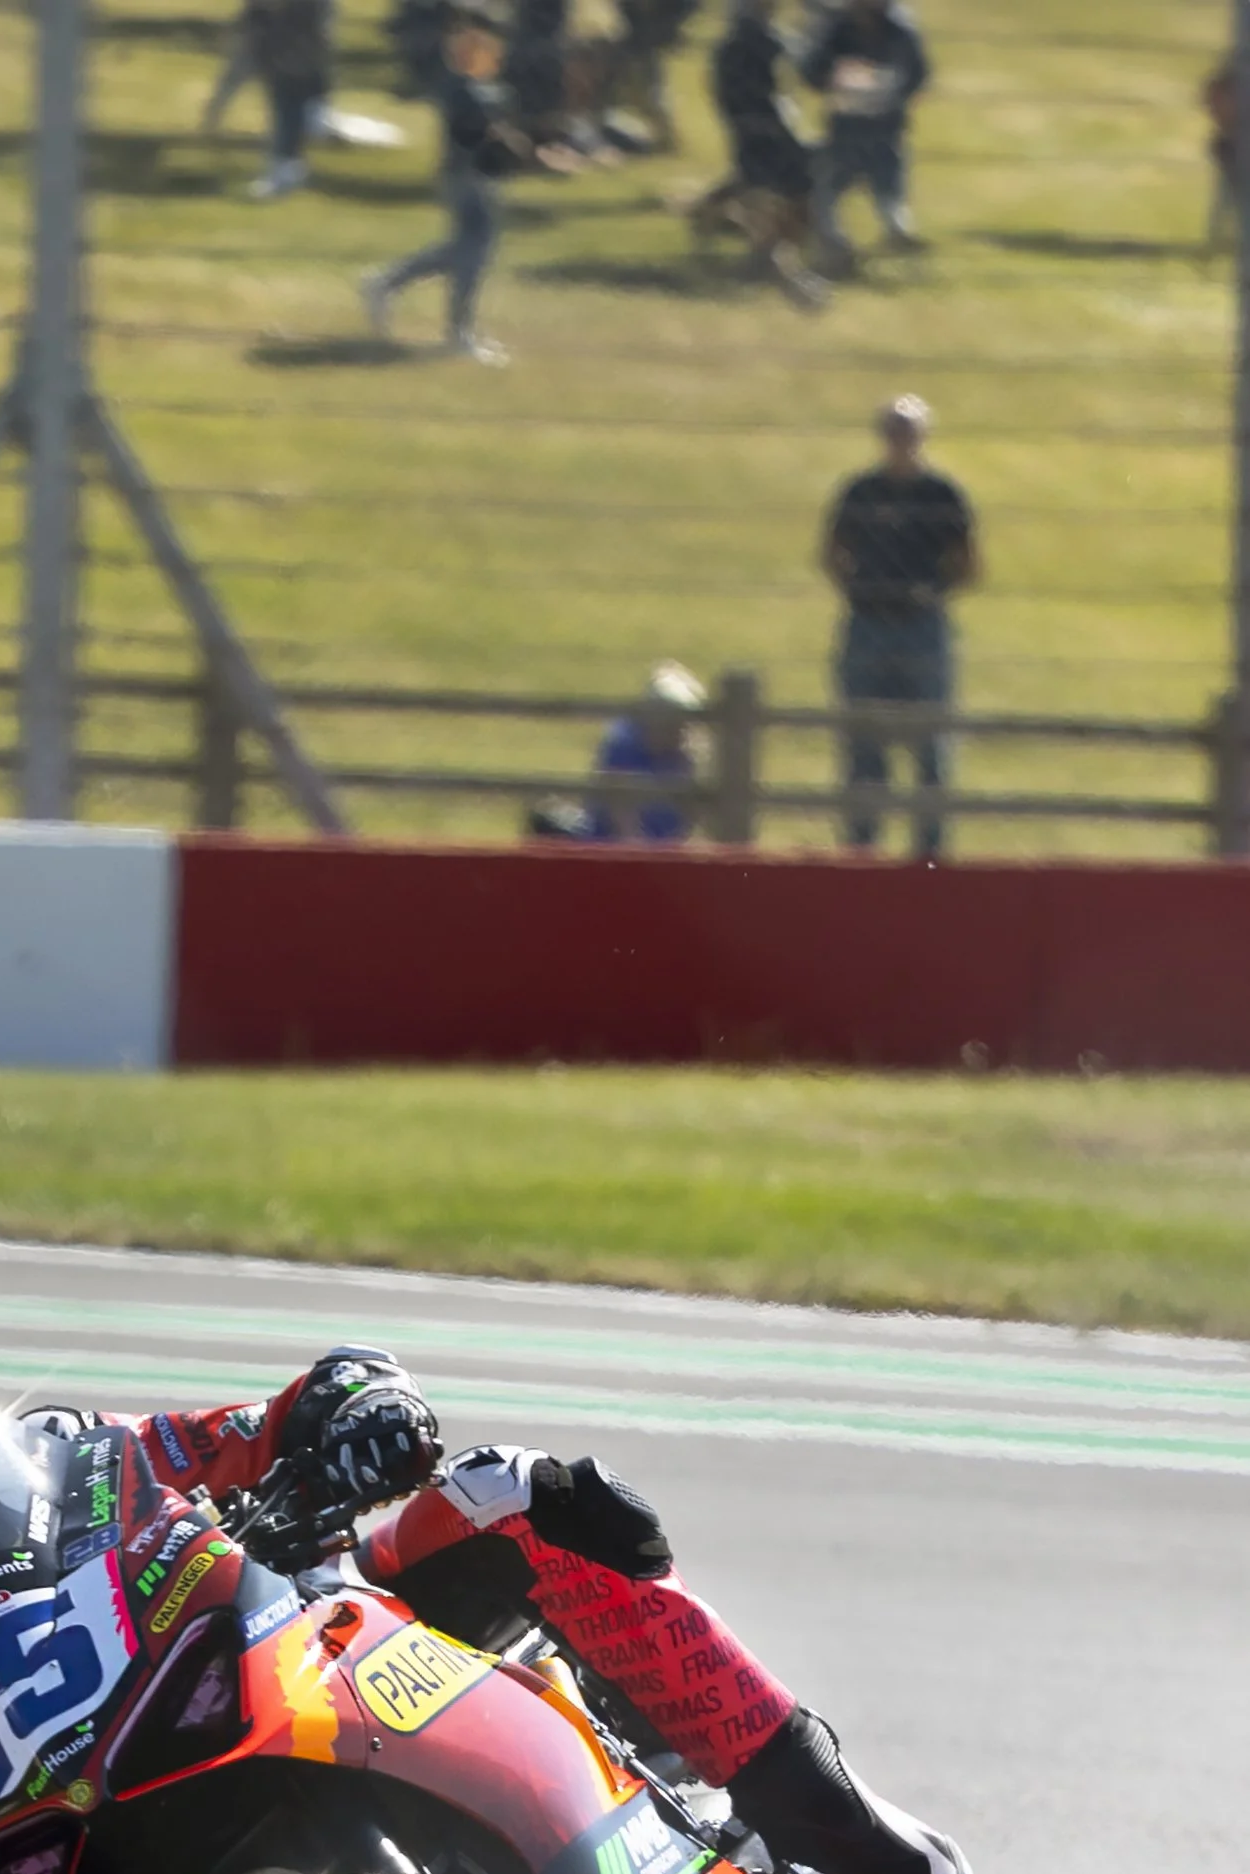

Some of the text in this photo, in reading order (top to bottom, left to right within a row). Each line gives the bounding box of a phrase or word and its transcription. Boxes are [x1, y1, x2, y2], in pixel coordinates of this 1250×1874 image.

[575, 1586, 668, 1642] THOMAS
[664, 1606, 712, 1648] THO
[366, 1634, 476, 1721] PALFIN
